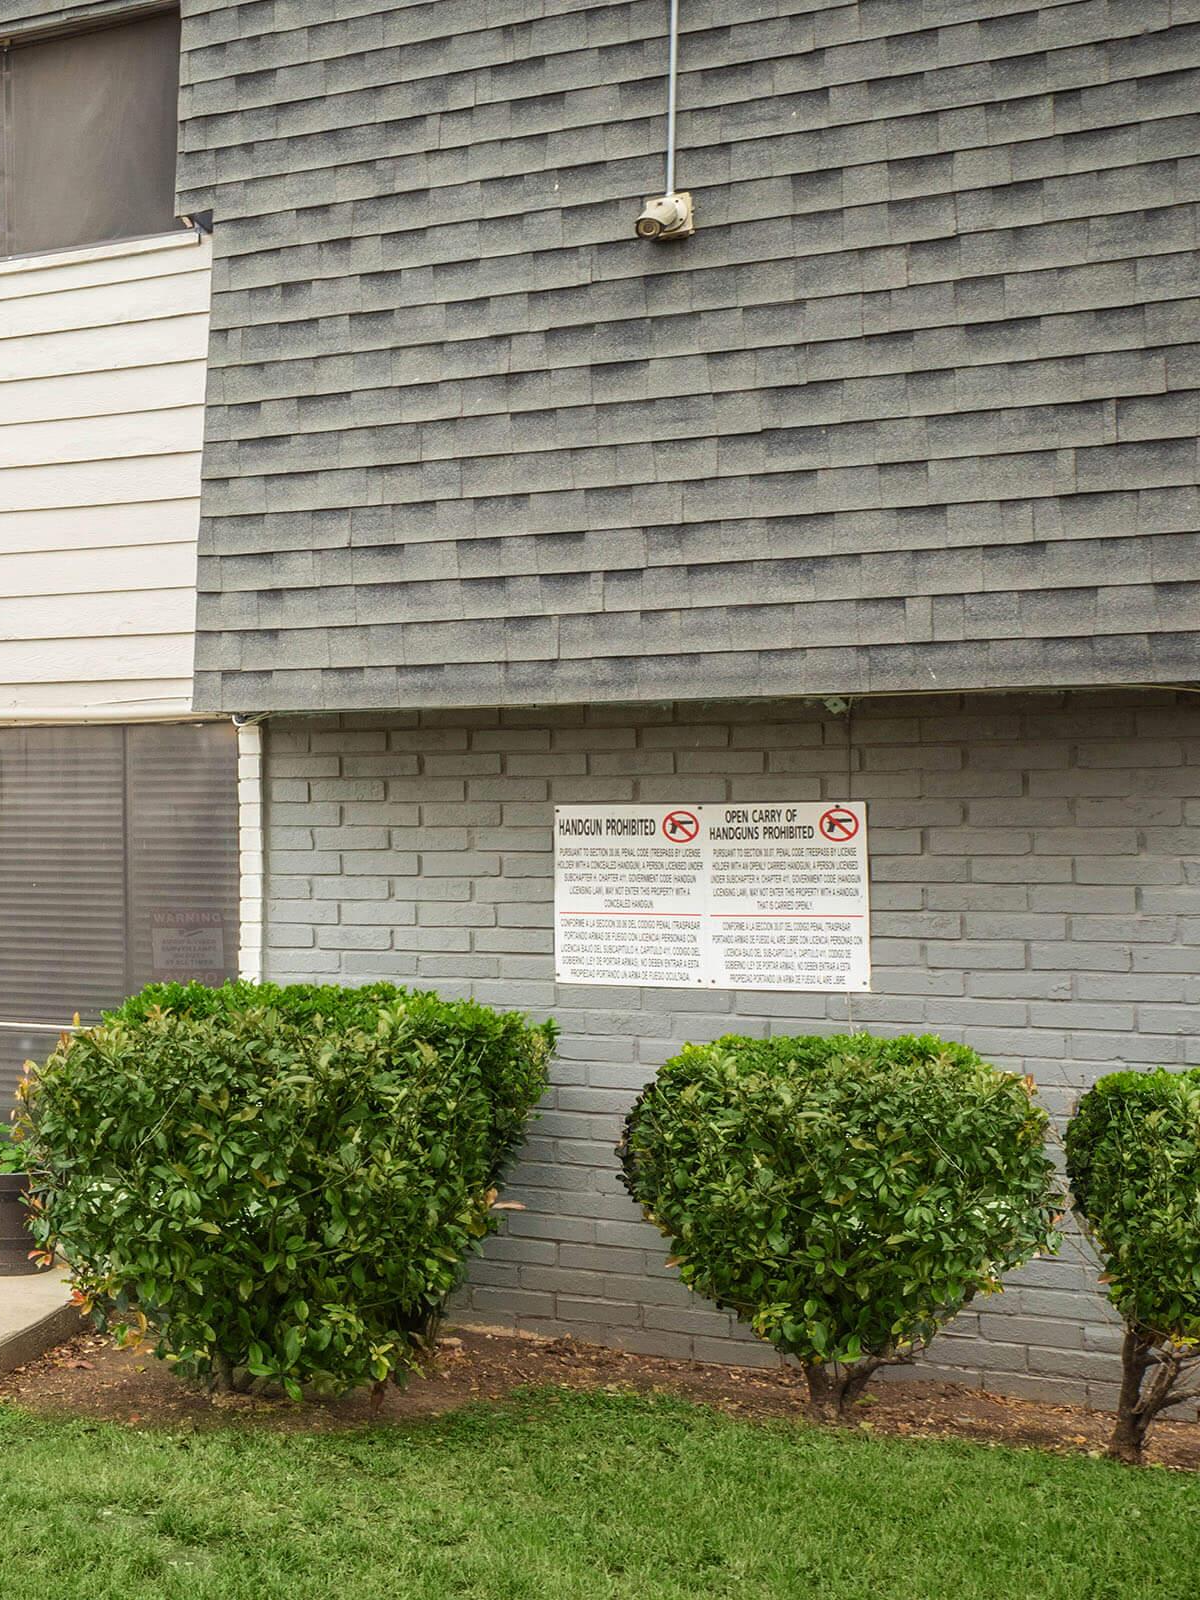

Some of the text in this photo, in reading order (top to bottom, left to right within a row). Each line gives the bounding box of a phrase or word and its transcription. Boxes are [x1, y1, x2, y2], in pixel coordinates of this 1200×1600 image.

[725, 809, 797, 823] OPEN CARRY OF
[559, 818, 656, 836] HANDGUN PROHIBITED
[710, 826, 814, 840] HANDGUNS PROHIBITED
[153, 912, 221, 922] WARNING
